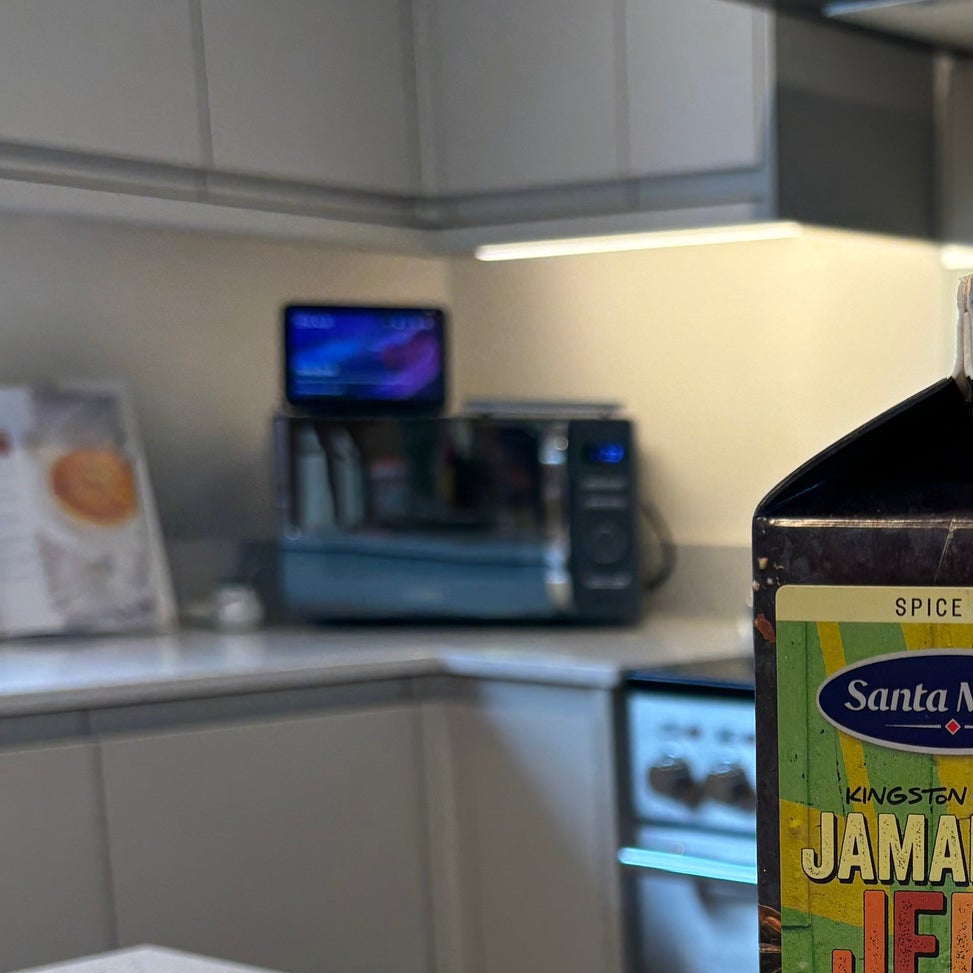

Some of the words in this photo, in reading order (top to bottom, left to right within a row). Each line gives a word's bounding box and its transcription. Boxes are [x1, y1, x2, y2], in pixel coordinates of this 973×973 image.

[895, 598, 962, 617] SPICE
[844, 679, 948, 714] Santa
[845, 786, 967, 806] KINGSTON
